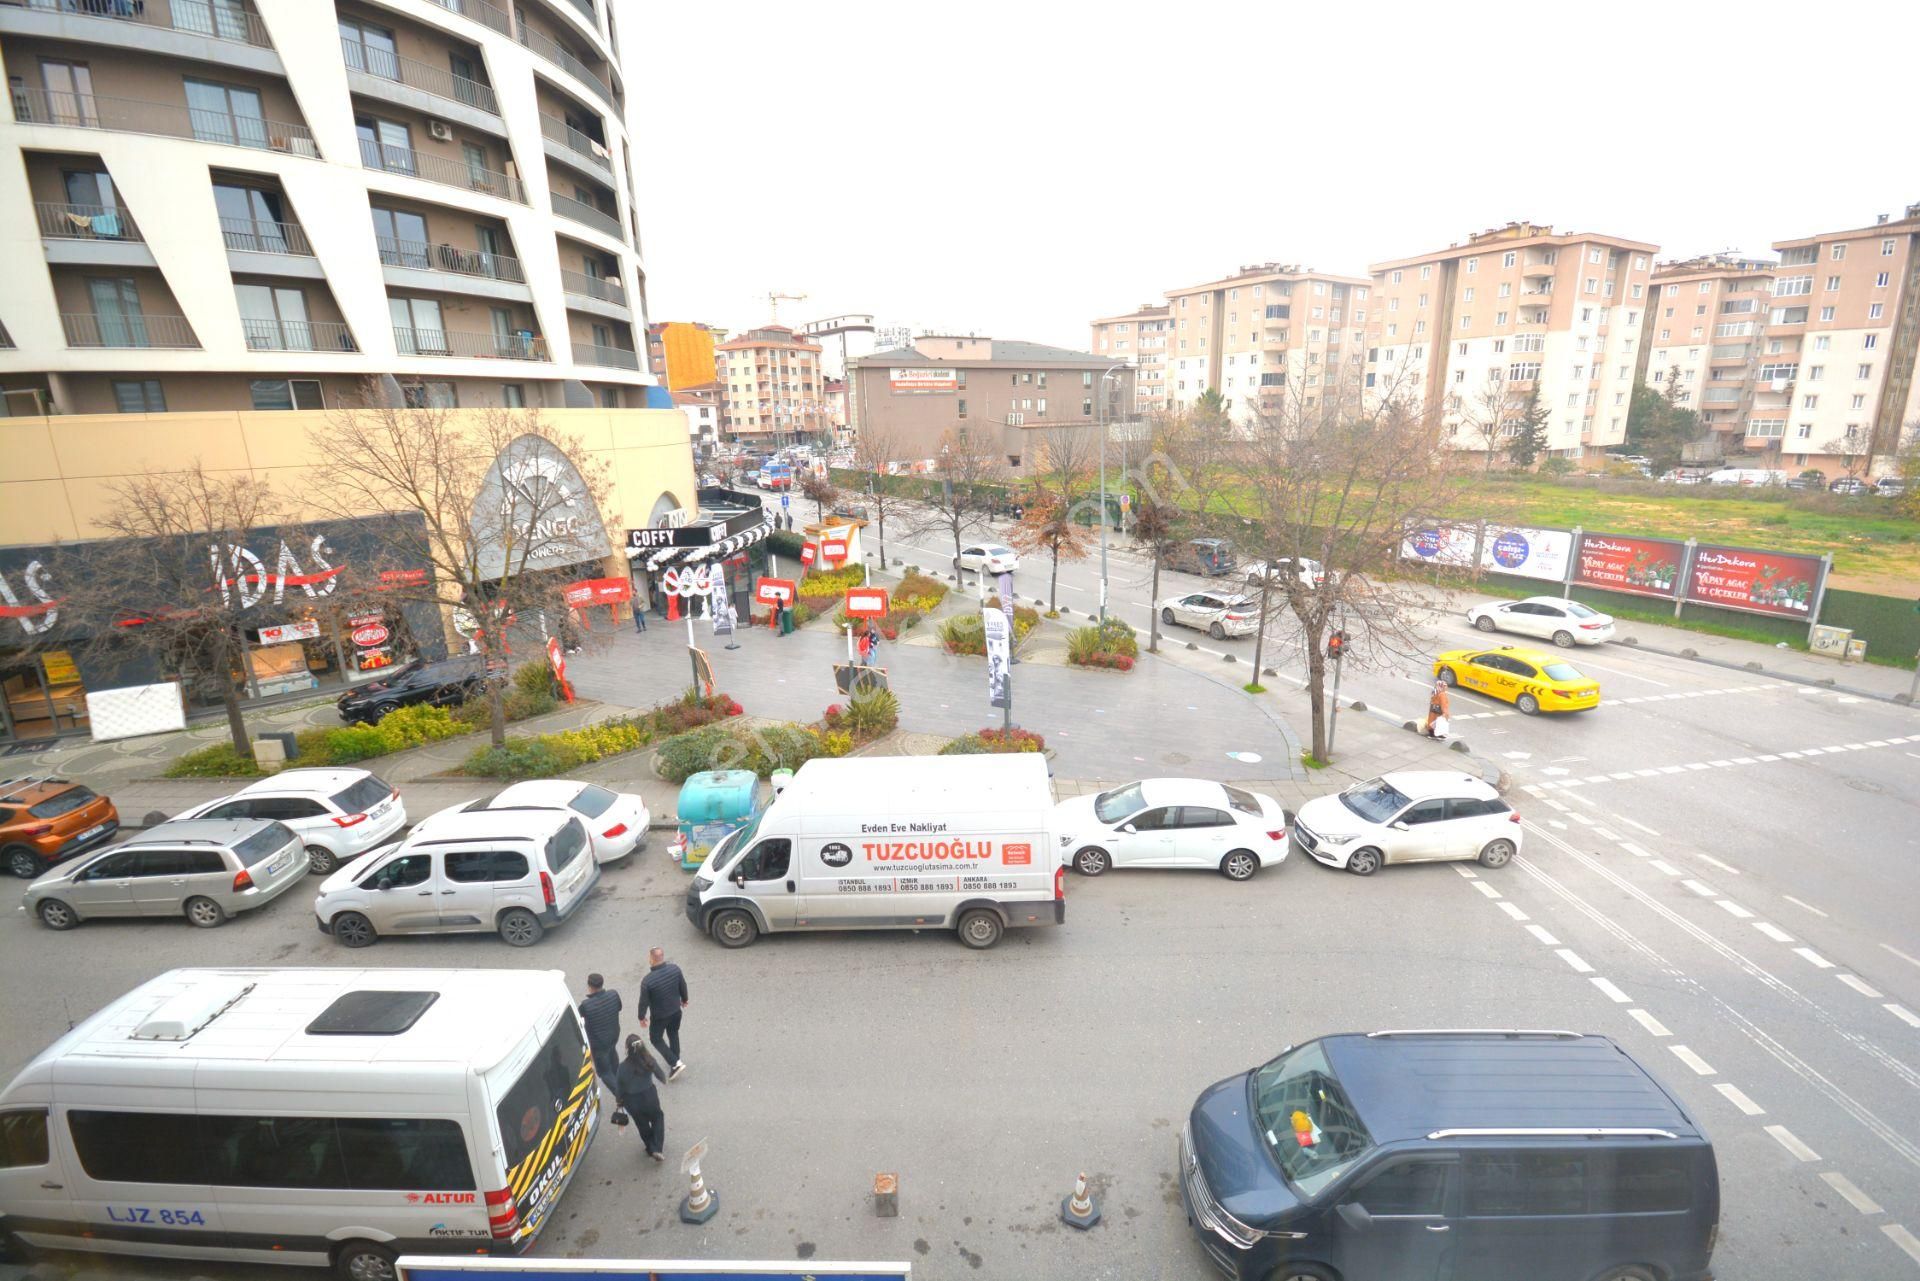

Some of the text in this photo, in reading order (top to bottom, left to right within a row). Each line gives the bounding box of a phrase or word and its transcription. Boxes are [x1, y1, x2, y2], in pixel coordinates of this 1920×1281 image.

[632, 529, 674, 546] COFFY
[1584, 538, 1632, 553] HerDekora
[1699, 552, 1757, 568] HerDekora
[1696, 571, 1726, 587] YAPAY
[1697, 586, 1707, 595] VE
[1496, 676, 1517, 688] Uber
[861, 822, 947, 833] Evden Eve Nakliyat
[862, 838, 992, 861] TUZCUOĞLU
[873, 863, 978, 872] www.tuzcuoglutasima.com.tr
[529, 1154, 563, 1206] OKUL
[424, 1193, 475, 1204] ALTUR
[107, 1206, 205, 1226] LJZ 854
